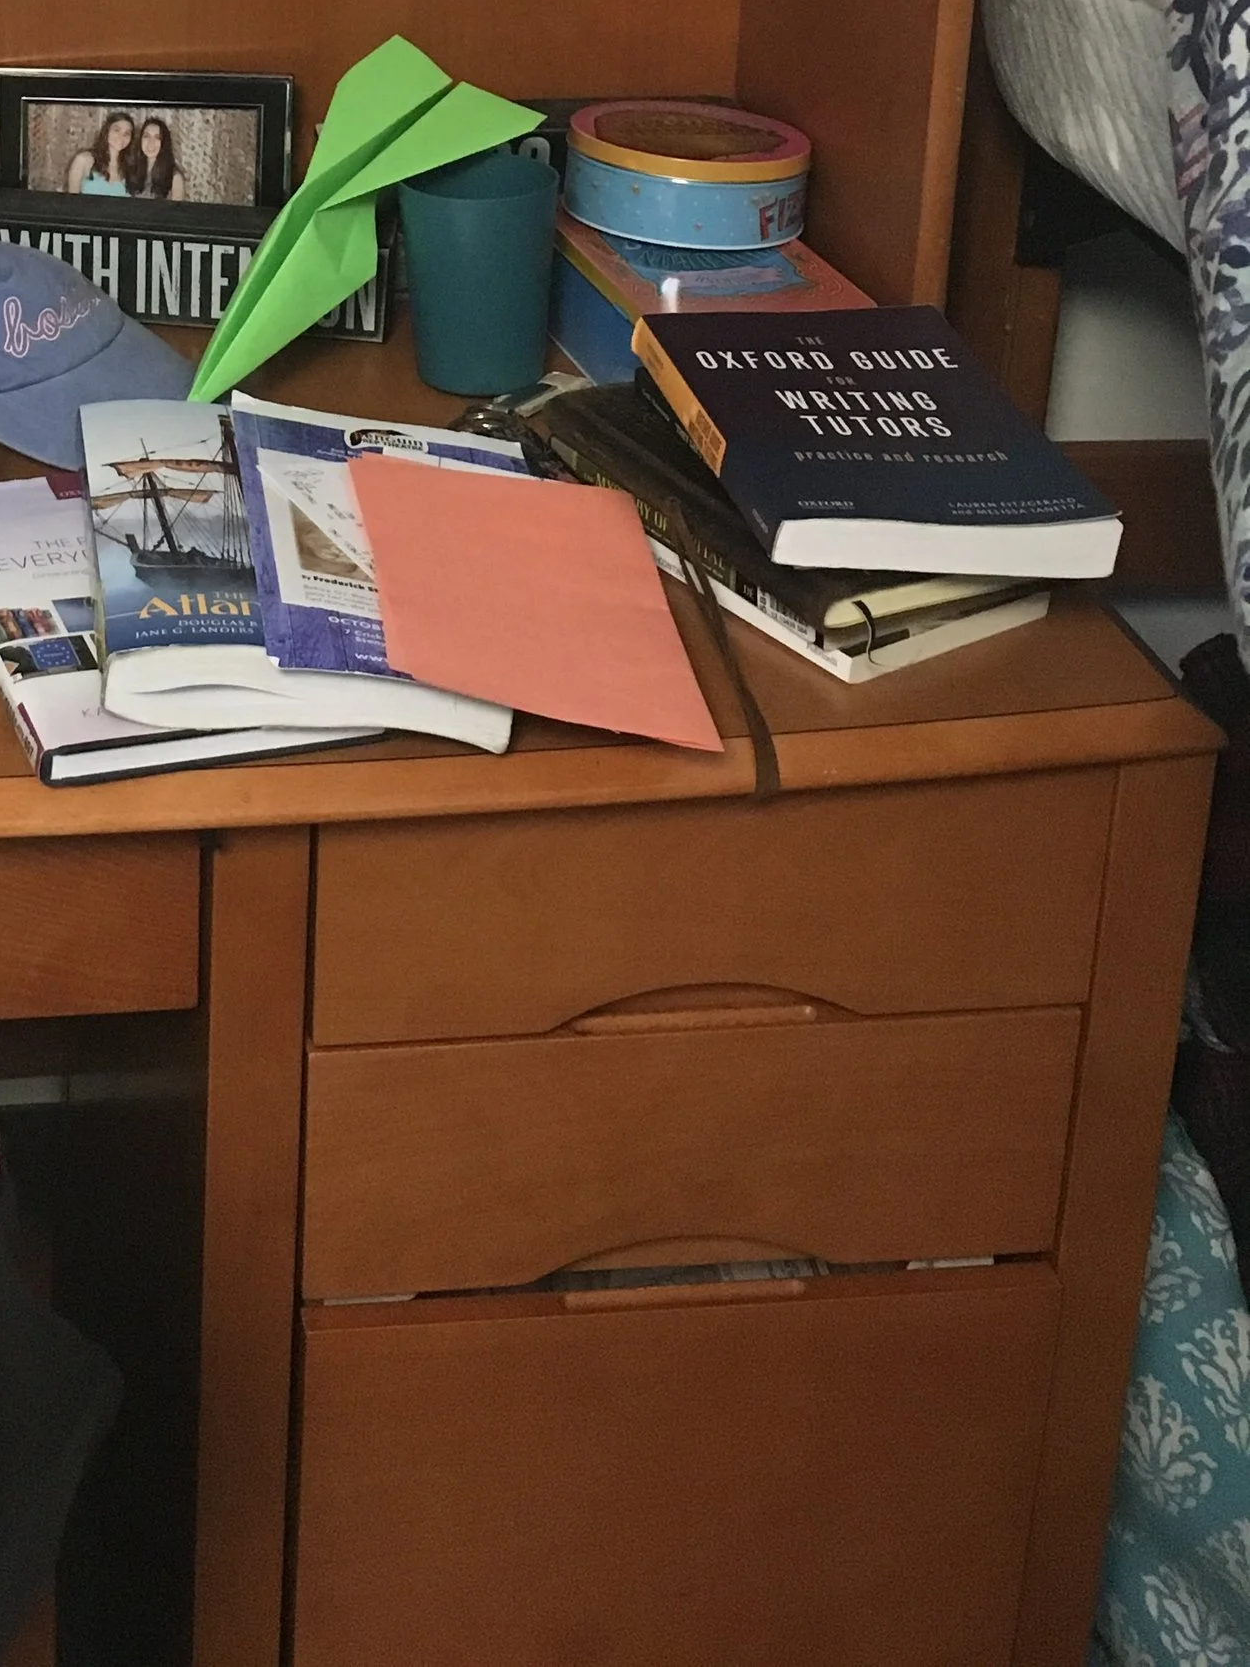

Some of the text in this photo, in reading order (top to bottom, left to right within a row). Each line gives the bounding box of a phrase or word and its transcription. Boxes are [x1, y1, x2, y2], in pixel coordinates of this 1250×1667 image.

[796, 336, 824, 347] THE
[695, 347, 959, 371] OXFORD GUIDE
[826, 376, 857, 386] FOR
[775, 389, 937, 411] WRITING
[800, 414, 953, 438] TUTORS
[794, 450, 1009, 463] practice and research
[1000, 497, 1077, 508] FITZGERALD
[977, 507, 1027, 515] MELISSA
[34, 538, 71, 550] THE
[214, 591, 247, 600] THE
[138, 593, 261, 620] Atlan
[178, 619, 245, 627] DOUGLAS
[328, 616, 382, 629] OCTOB
[135, 629, 167, 639] JANE
[191, 626, 255, 634] LANDERS
